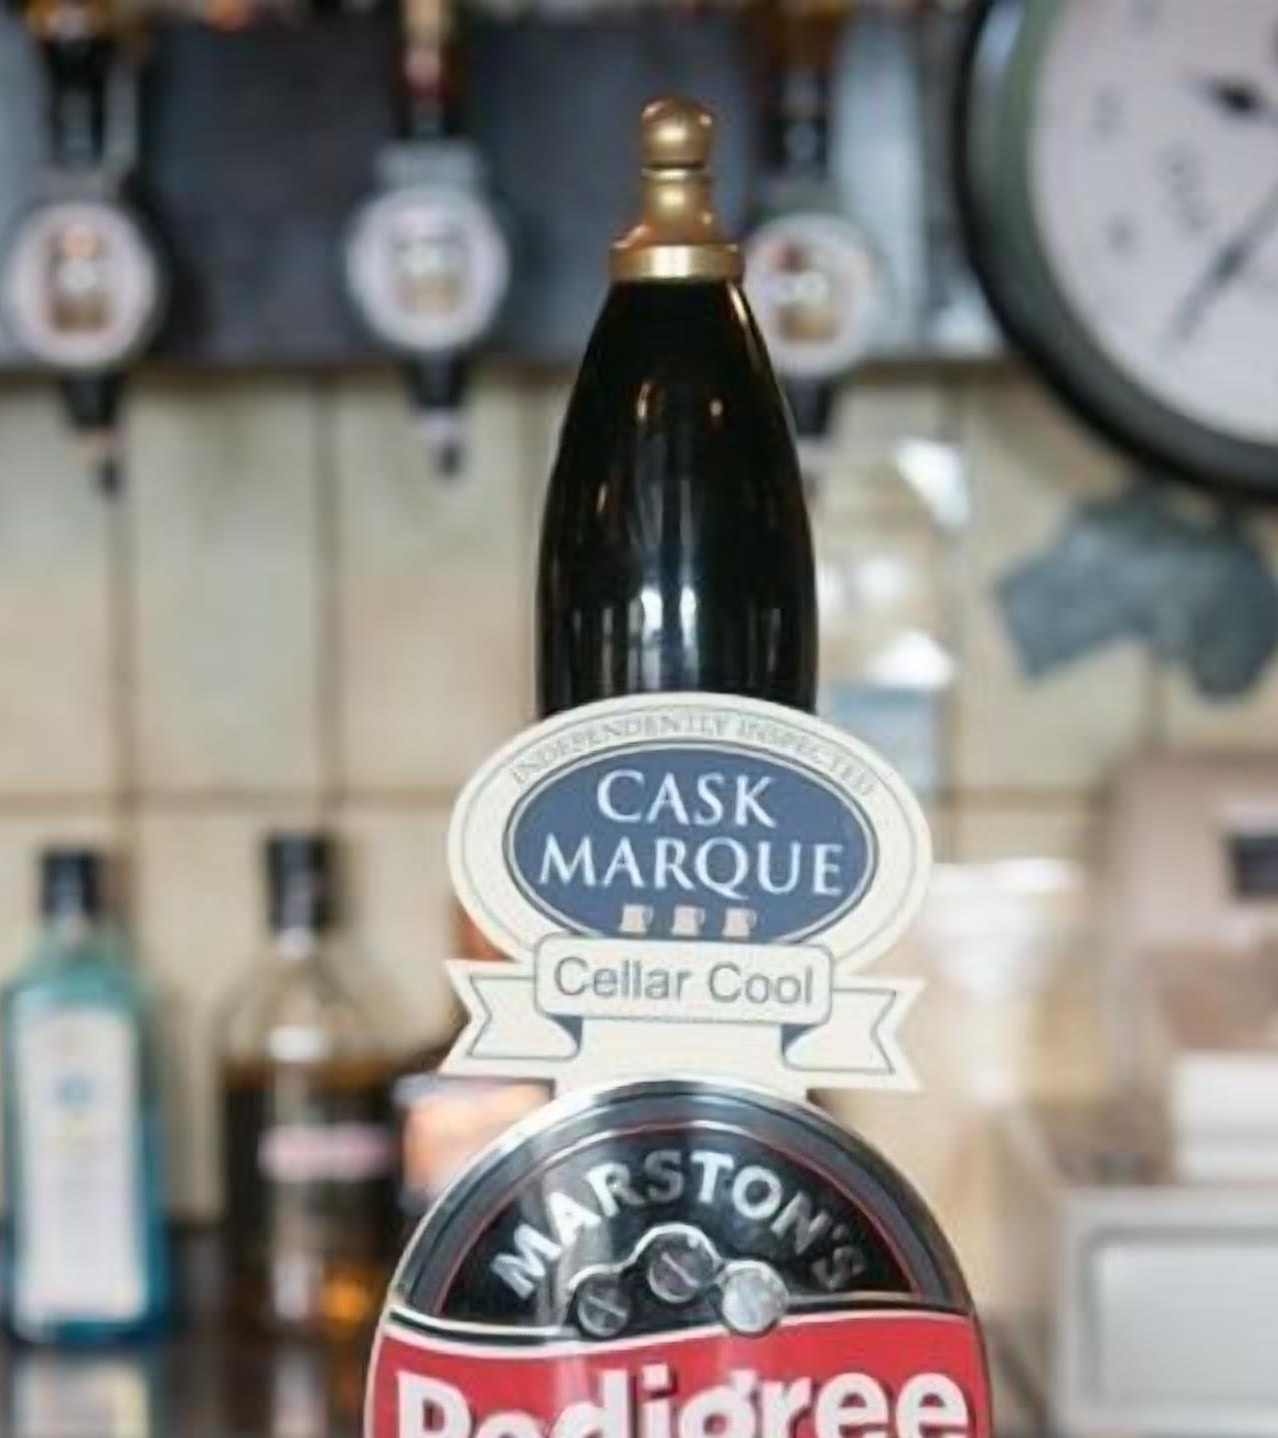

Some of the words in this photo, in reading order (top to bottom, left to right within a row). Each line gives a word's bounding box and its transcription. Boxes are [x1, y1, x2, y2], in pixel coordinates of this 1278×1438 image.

[597, 769, 778, 829] CASK
[538, 833, 845, 901] MARQUE
[553, 955, 692, 1002] Cellar
[707, 961, 814, 1007] Cool
[489, 1150, 869, 1300] MARSTON'S
